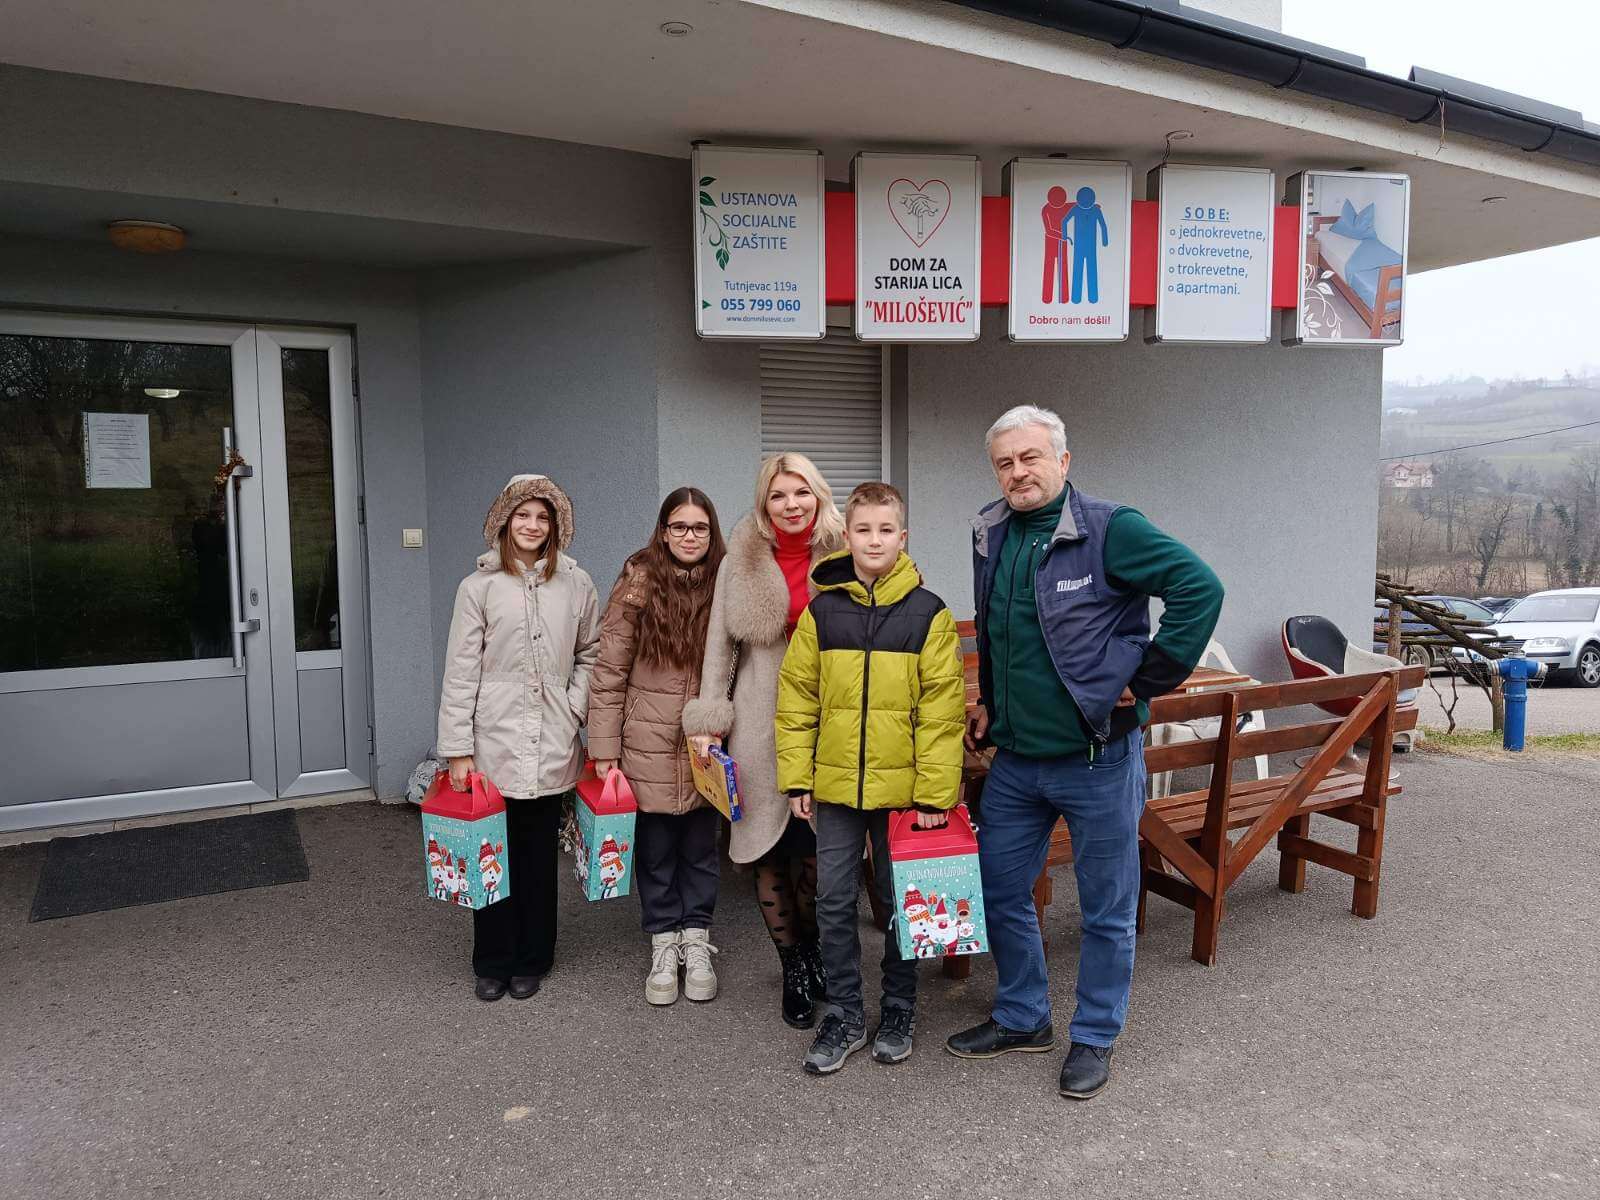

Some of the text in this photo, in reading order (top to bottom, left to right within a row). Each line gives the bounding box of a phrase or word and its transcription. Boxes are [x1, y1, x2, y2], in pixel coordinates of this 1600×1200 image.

[721, 192, 797, 207] USTANOVA
[722, 213, 797, 229] SOCIJALNE
[1178, 225, 1266, 242] jednokrevetne,
[732, 233, 787, 250] ZAŠTITE
[1177, 243, 1253, 260] dvokrevetne,
[890, 258, 948, 272] DOM ZA
[1177, 263, 1249, 279] trokrevetne,
[724, 280, 797, 293] Tutnjevac 119a
[875, 275, 963, 290] STARIJA LICA
[1176, 282, 1241, 296] apartmani.
[721, 298, 801, 312] 055 799 060
[1029, 315, 1111, 325] Dobro nam došli!
